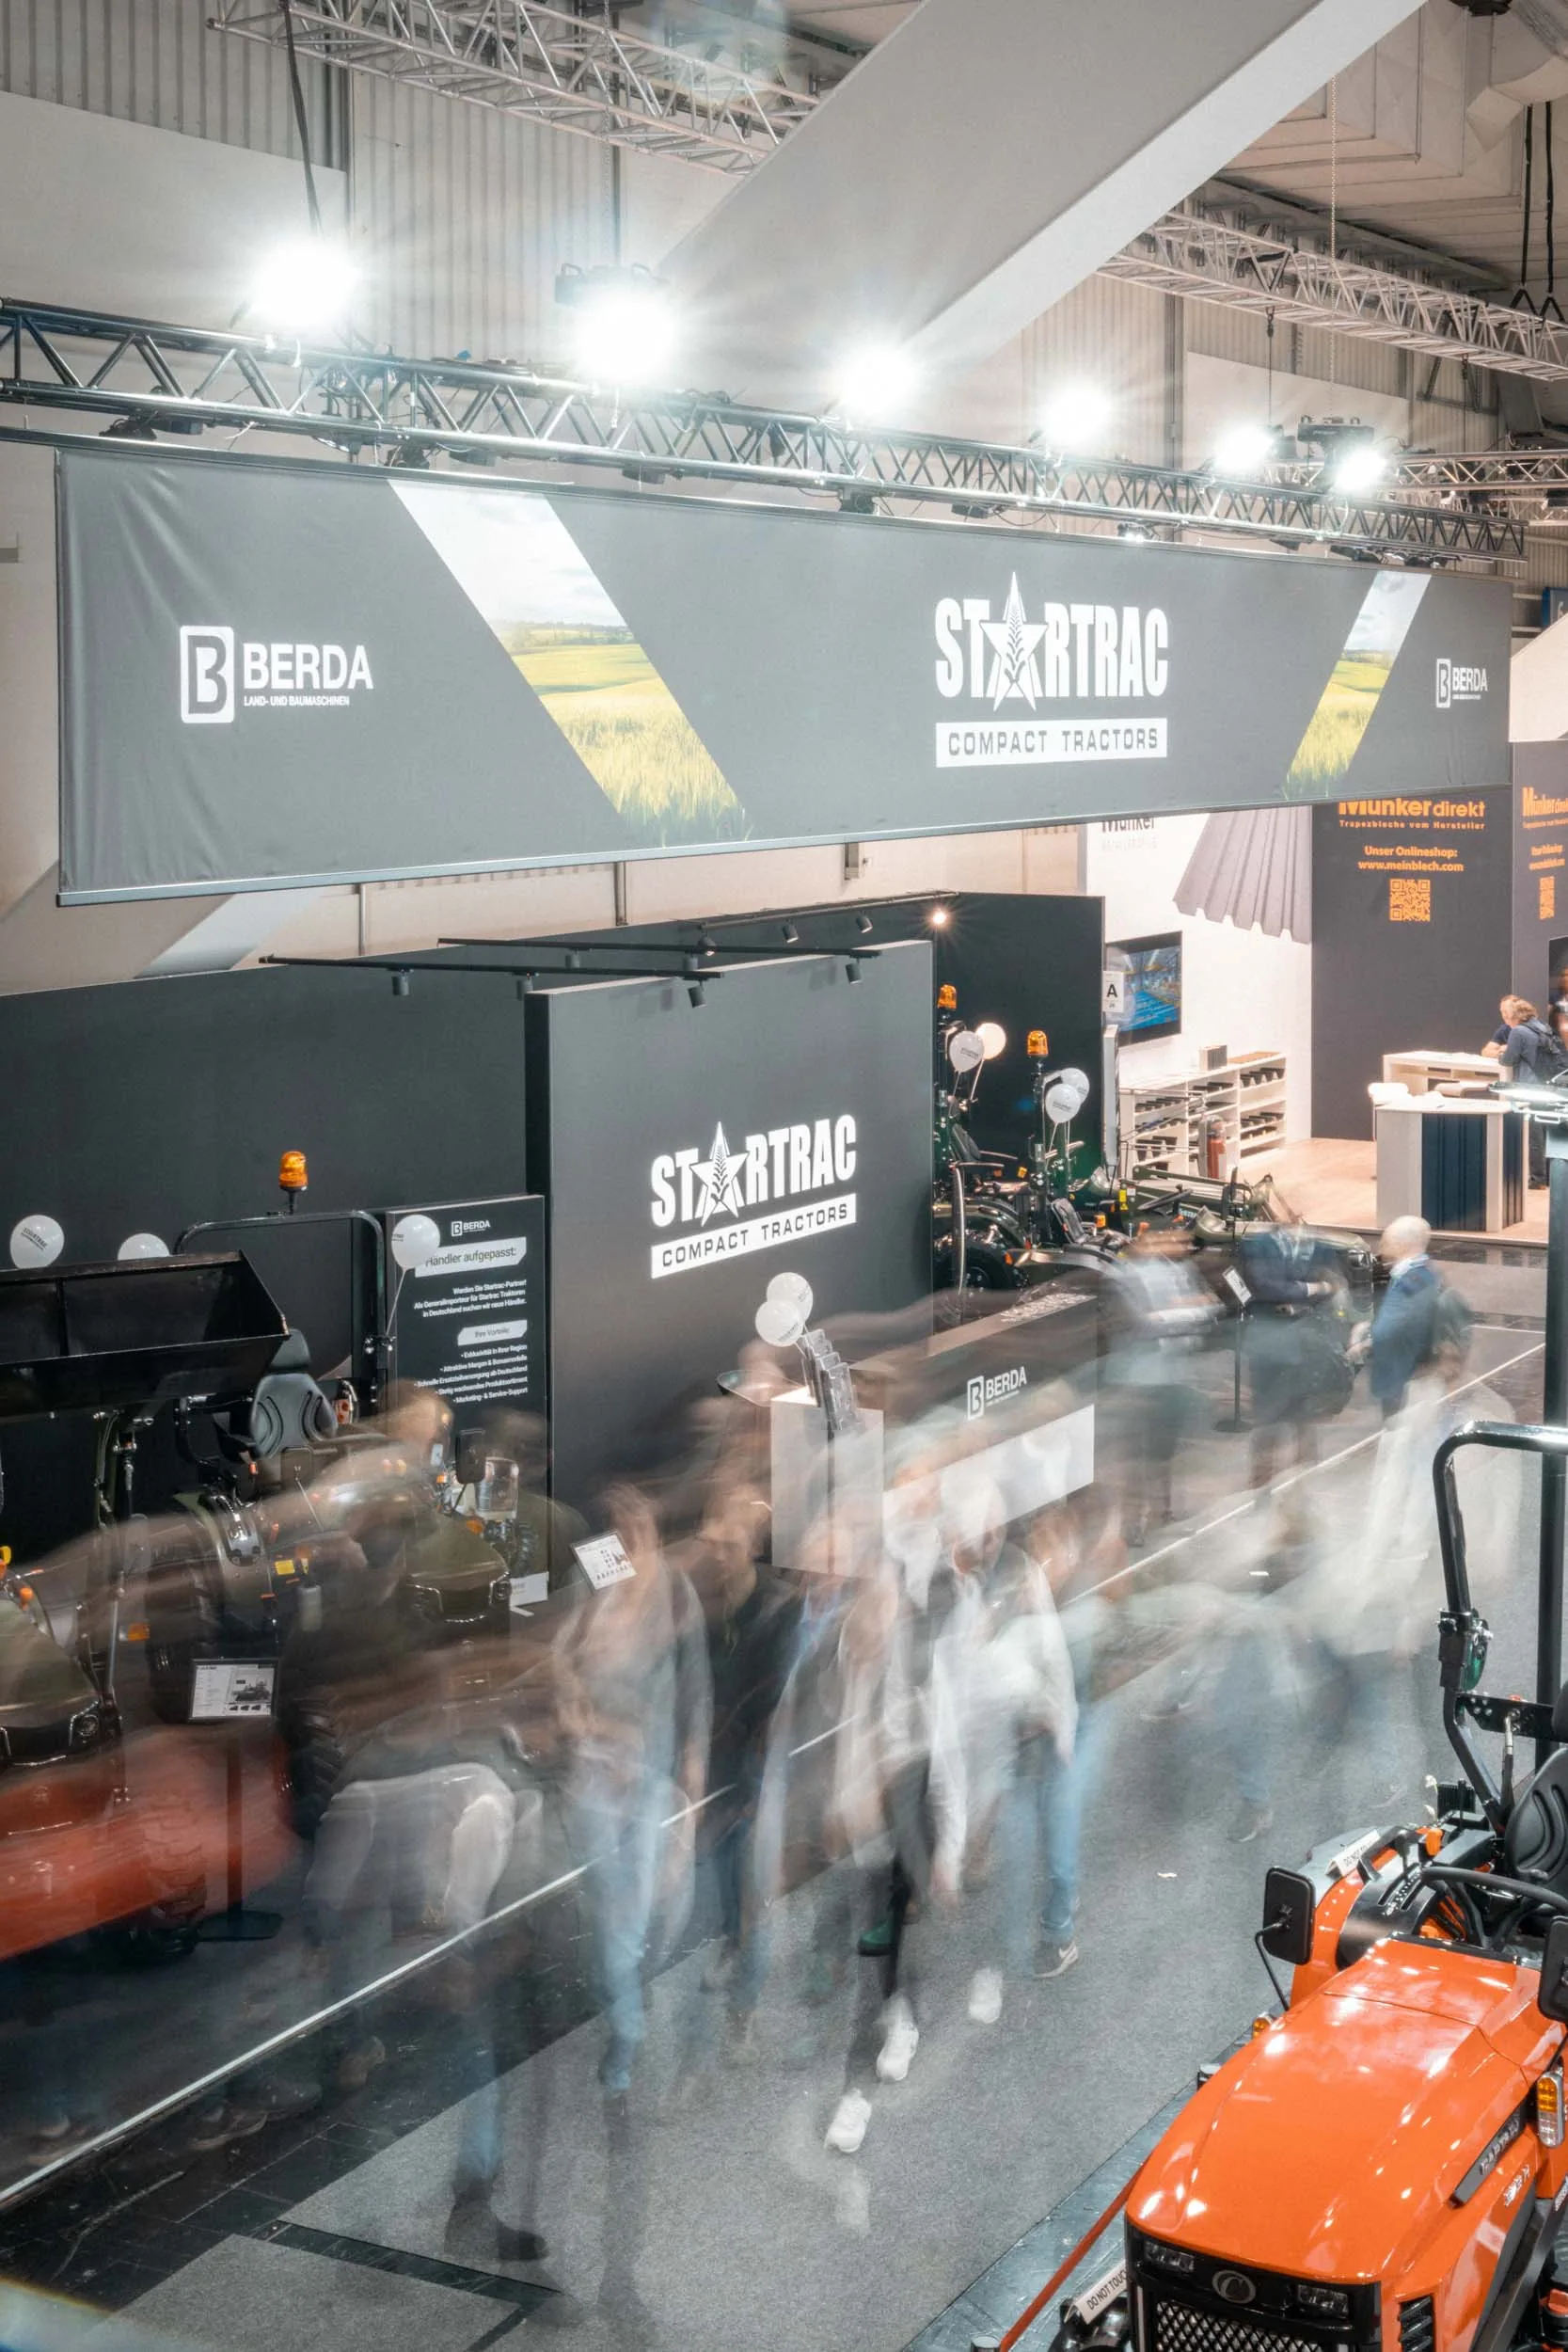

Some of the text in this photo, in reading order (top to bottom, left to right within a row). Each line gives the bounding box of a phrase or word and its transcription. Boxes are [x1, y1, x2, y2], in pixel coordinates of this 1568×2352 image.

[935, 571, 1168, 712] STARTRAC
[243, 643, 374, 690] BERDA
[1452, 667, 1488, 691] BERDA
[244, 695, 350, 707] LAND- UND BAUMASCHINEN
[948, 728, 1158, 755] COMPACT TRACTORS
[1358, 860, 1464, 872] www.meinblech.com
[1365, 846, 1458, 859] Unser Onlineshop:
[1106, 983, 1117, 997] A
[651, 1114, 856, 1227] STARTRAC
[463, 1220, 490, 1231] BERDA
[663, 1203, 847, 1267] COMPACT TRACTORS
[986, 1366, 1027, 1400] BERDA
[1086, 2269, 1127, 2311] DO NOT TOUC
